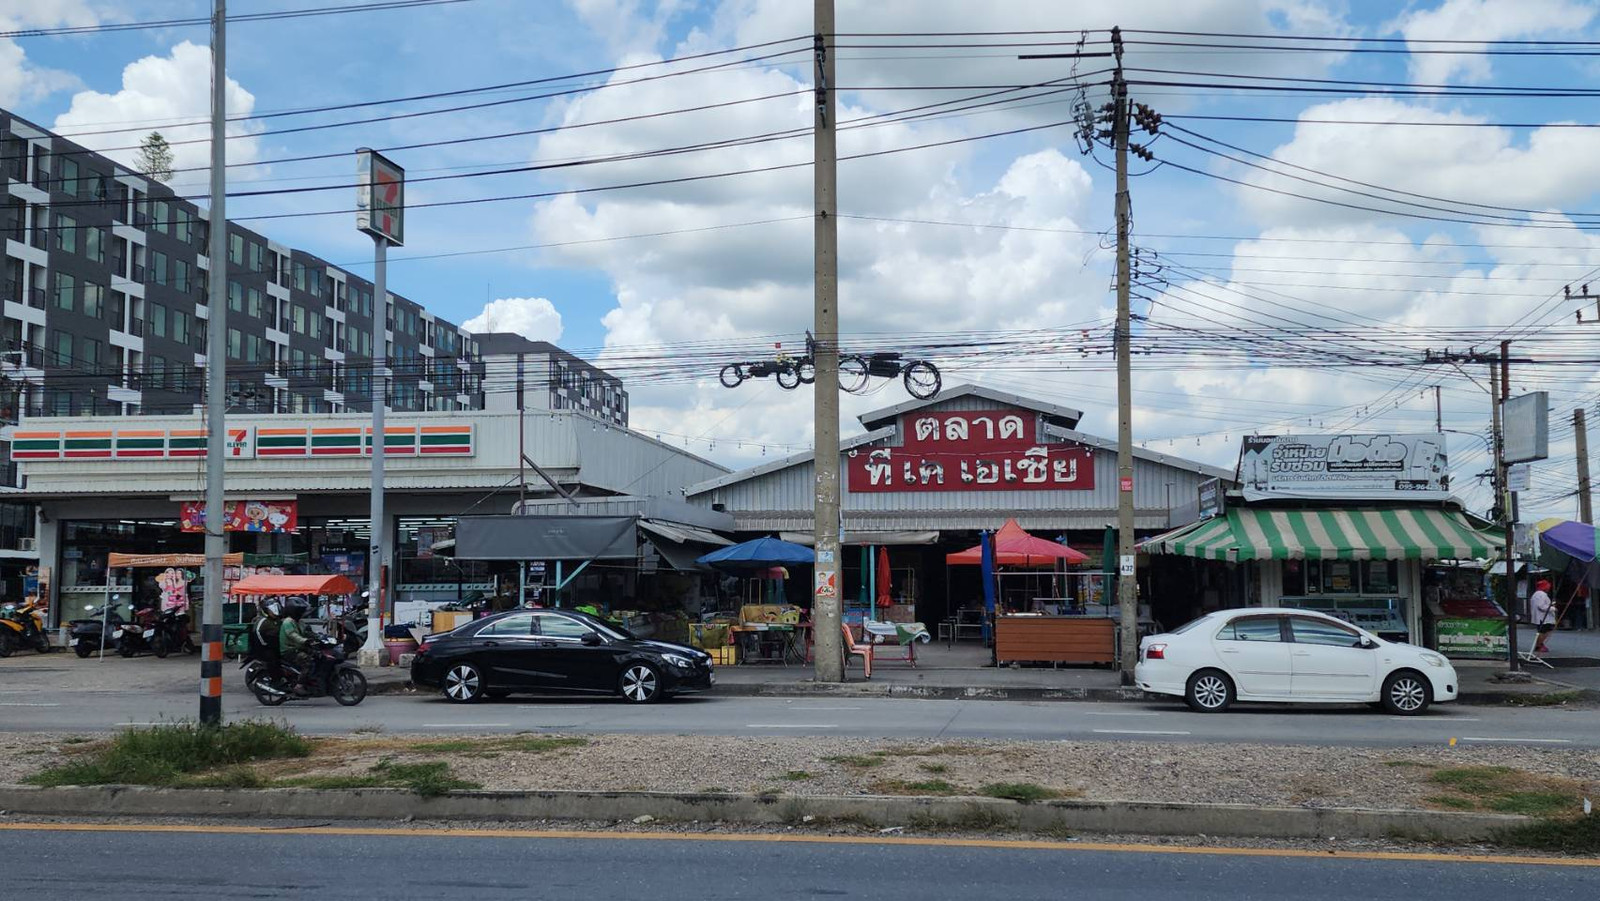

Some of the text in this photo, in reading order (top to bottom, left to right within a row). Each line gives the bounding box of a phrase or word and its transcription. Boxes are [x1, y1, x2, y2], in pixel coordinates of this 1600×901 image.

[915, 415, 1024, 441] ตลาด
[228, 429, 247, 456] 7
[864, 448, 892, 485] ที
[903, 459, 945, 485] เค
